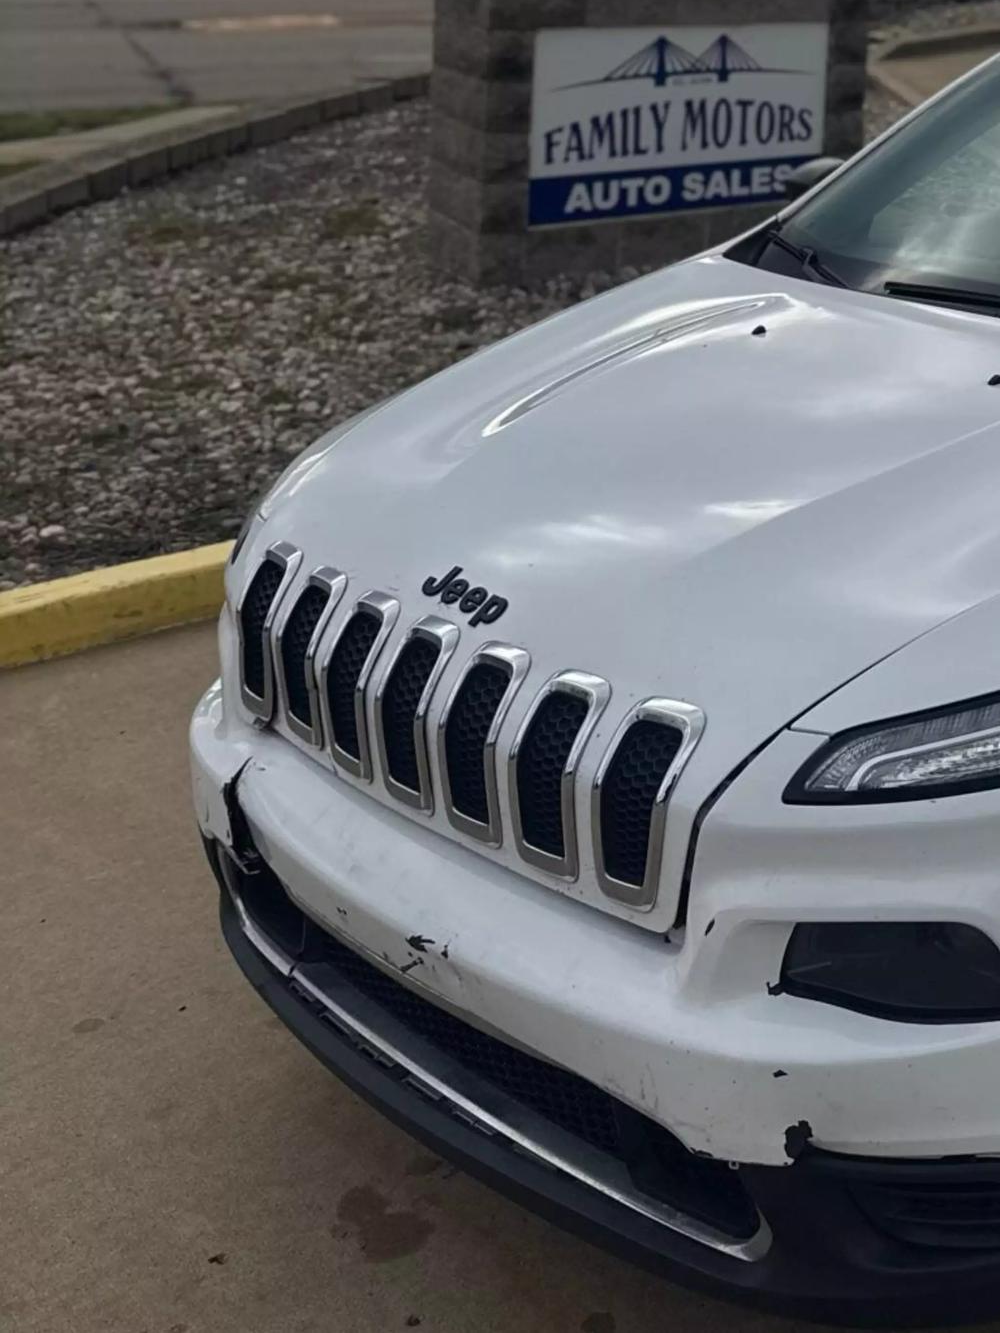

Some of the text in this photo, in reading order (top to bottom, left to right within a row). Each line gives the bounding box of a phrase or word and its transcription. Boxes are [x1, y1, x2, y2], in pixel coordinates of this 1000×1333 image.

[543, 97, 813, 166] FAMILY MOTORS
[564, 164, 793, 214] AUTO SALES
[422, 565, 509, 628] Jeep
